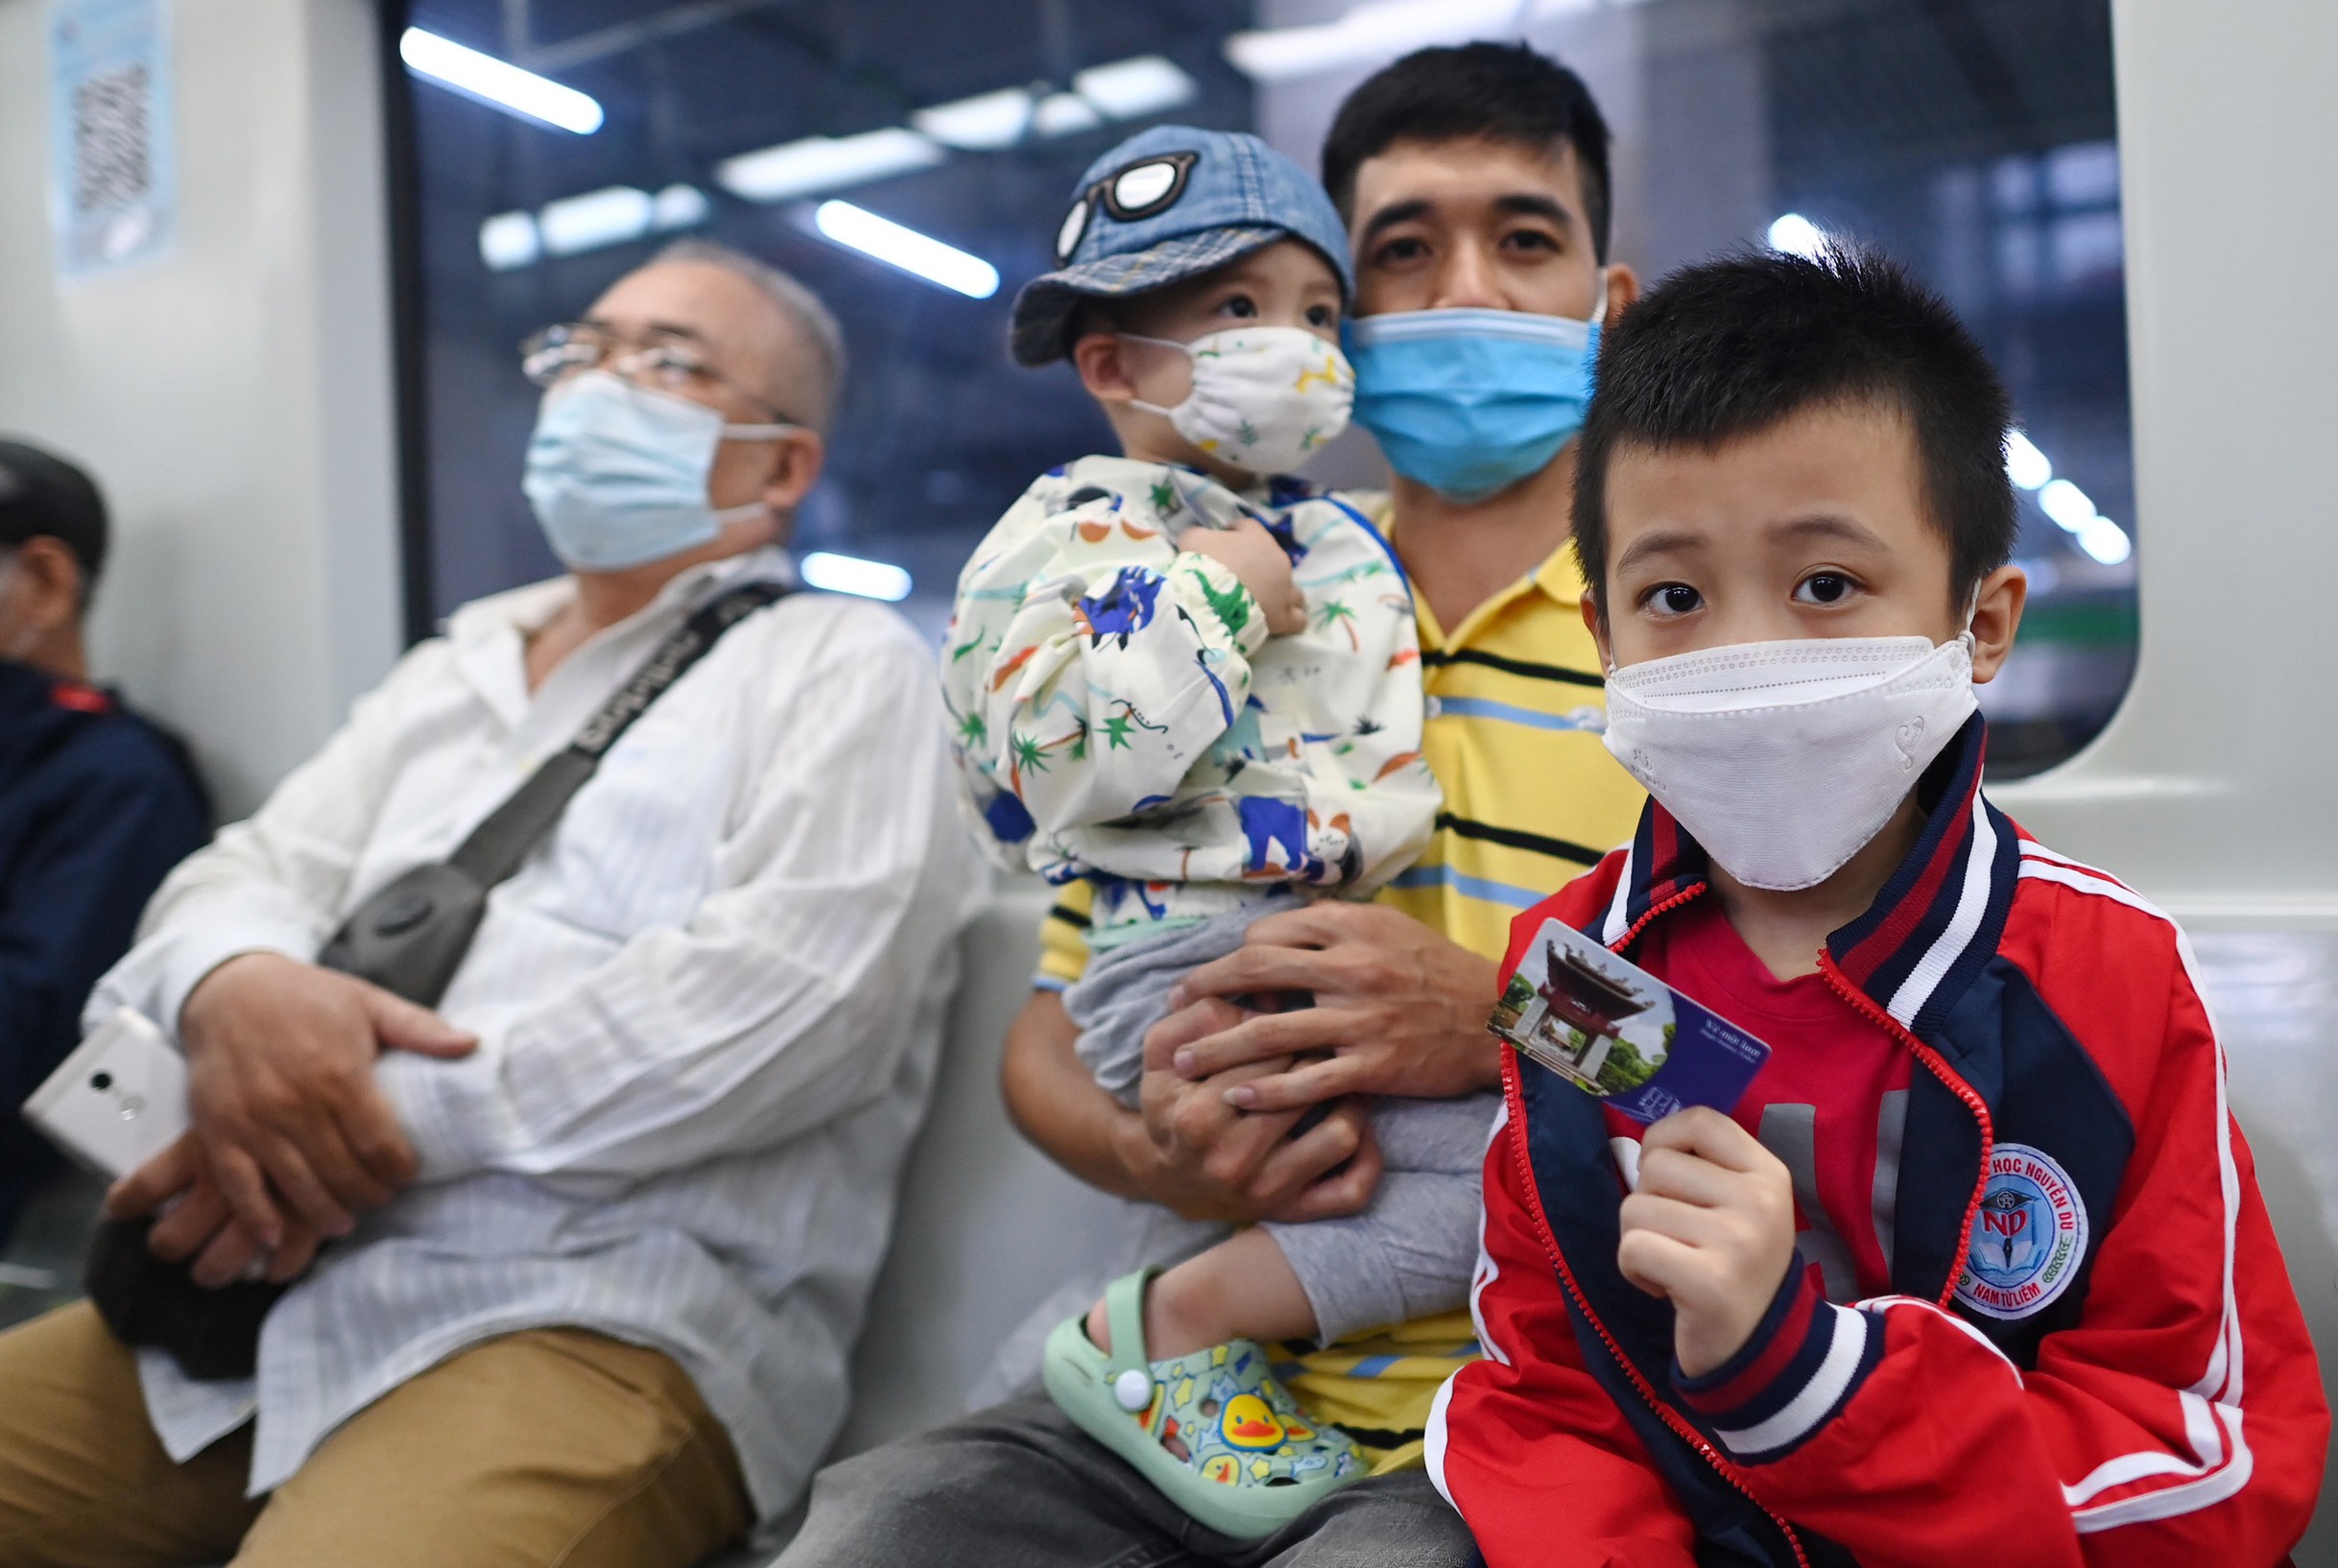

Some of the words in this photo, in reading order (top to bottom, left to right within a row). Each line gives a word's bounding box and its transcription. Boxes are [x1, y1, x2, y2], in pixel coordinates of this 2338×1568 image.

[1983, 1209, 2027, 1236] ND
[2058, 1211, 2073, 1230] DU
[1973, 1283, 2000, 1305] NAM
